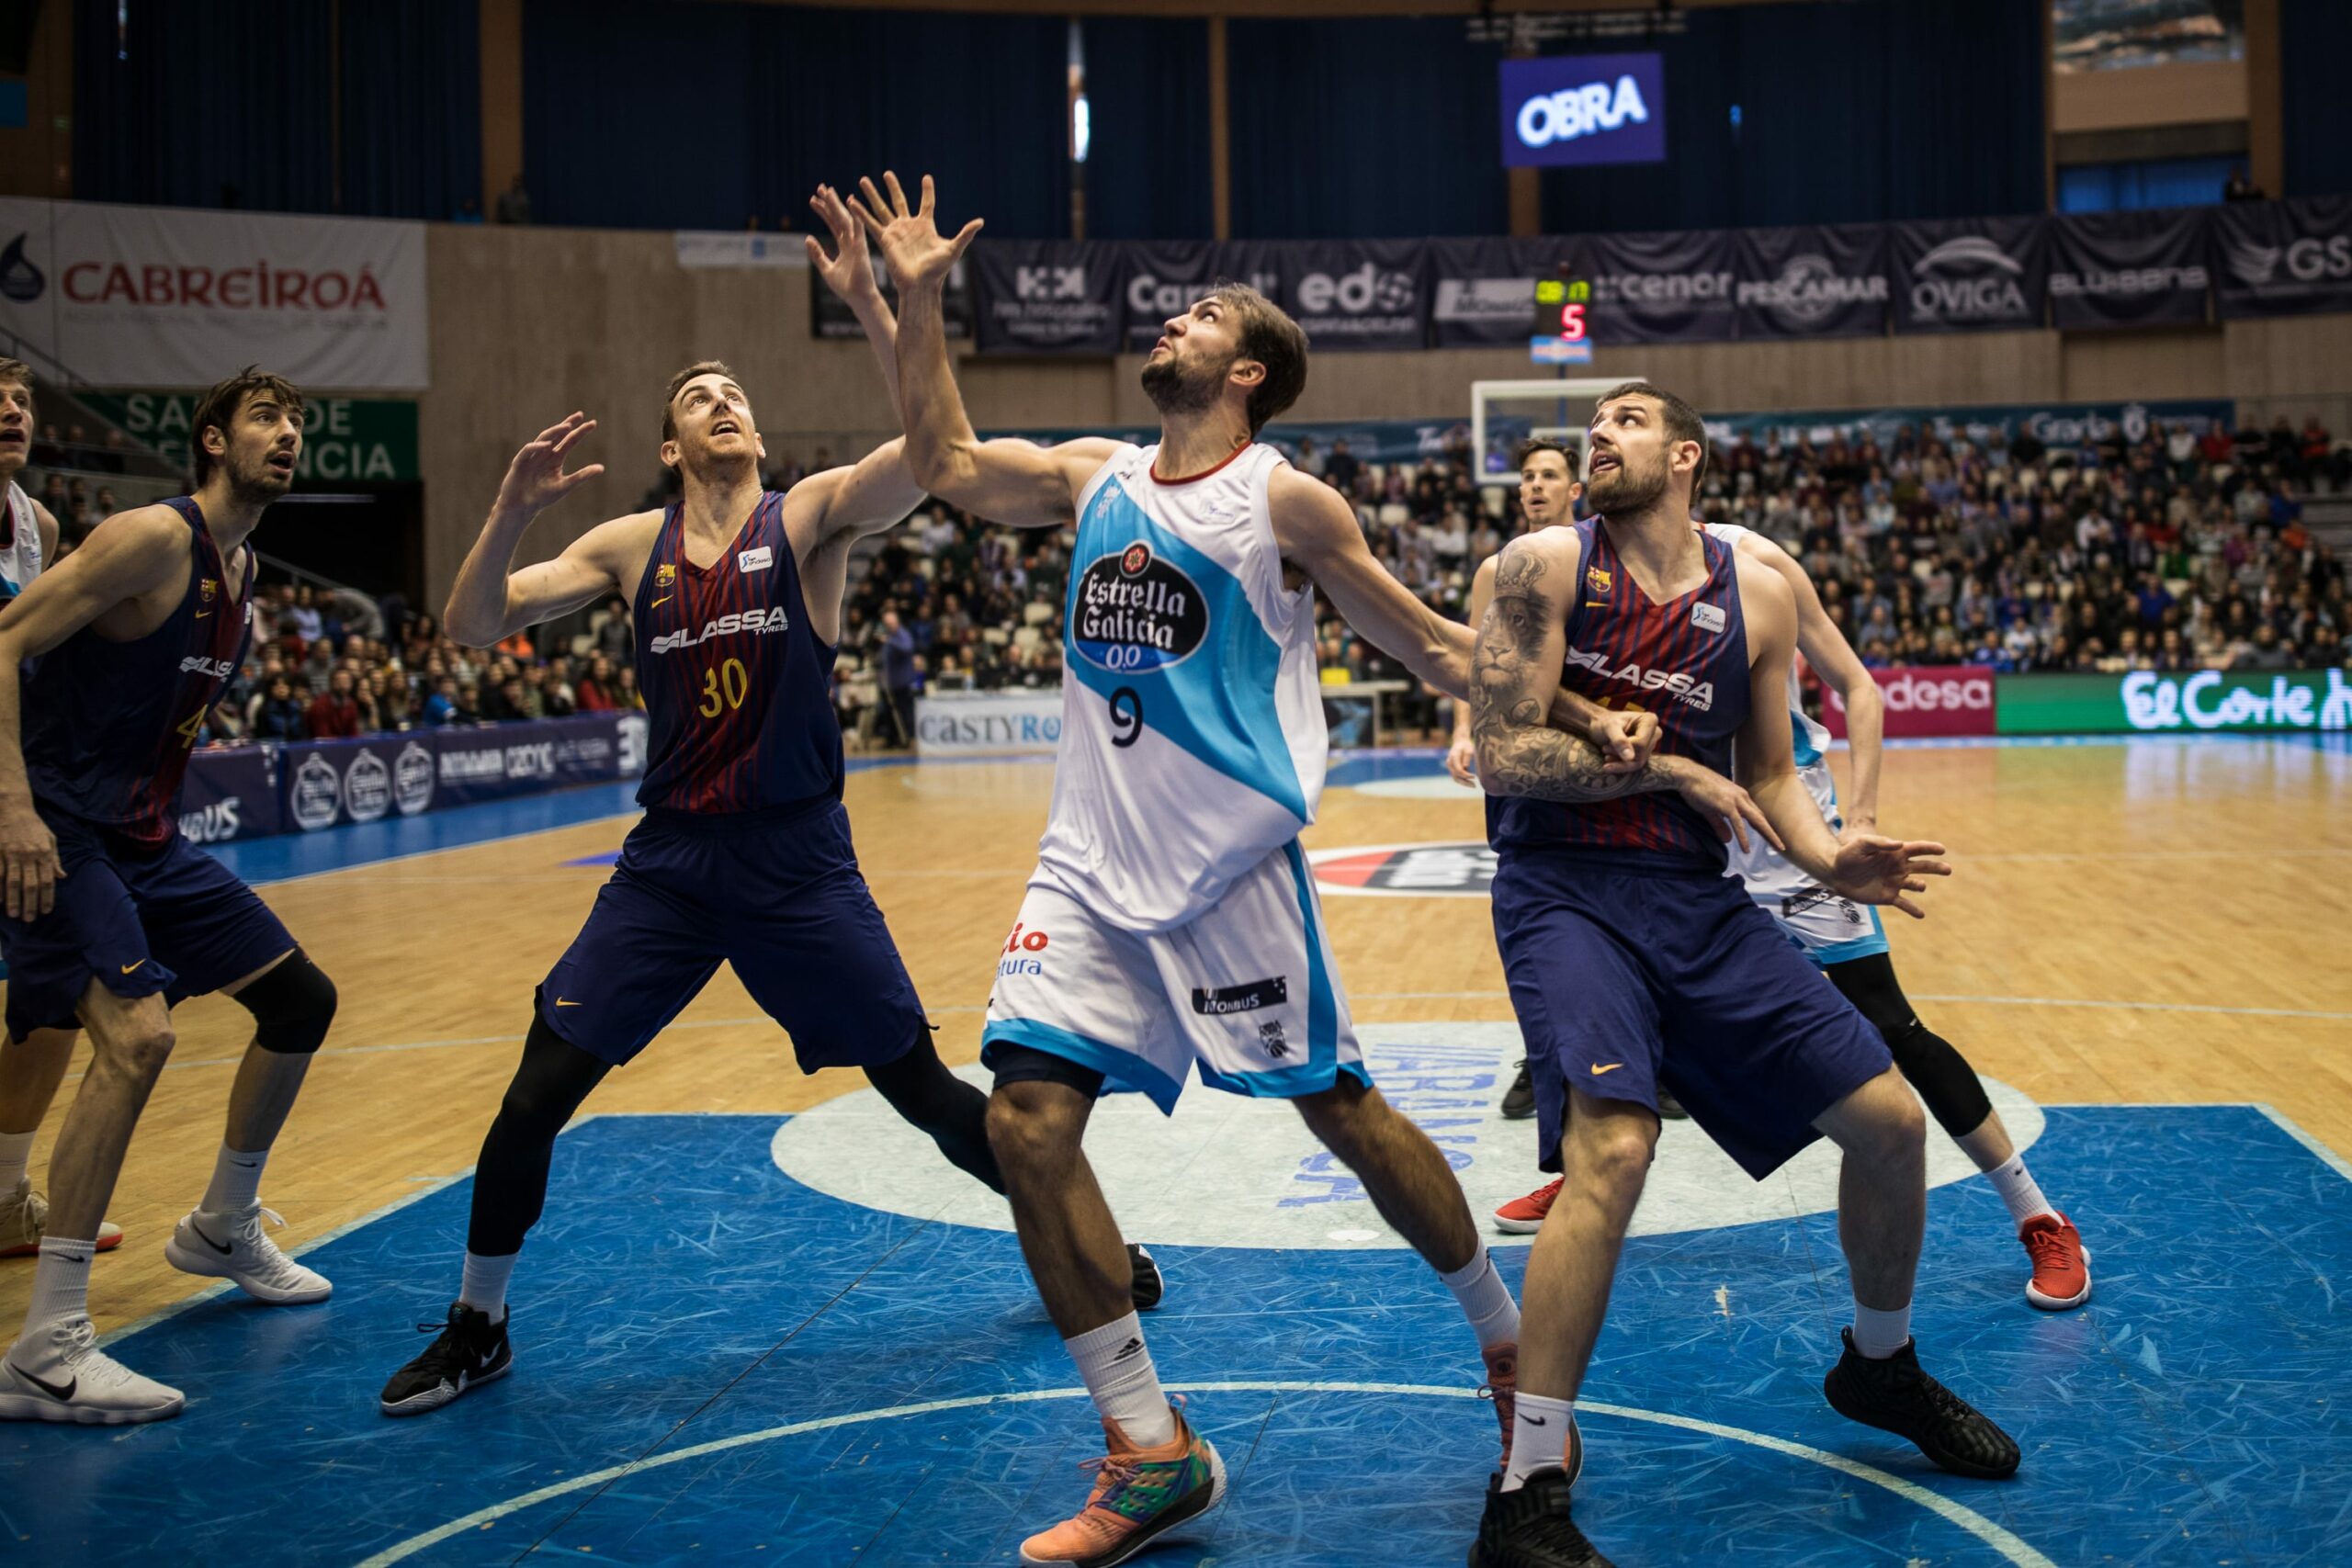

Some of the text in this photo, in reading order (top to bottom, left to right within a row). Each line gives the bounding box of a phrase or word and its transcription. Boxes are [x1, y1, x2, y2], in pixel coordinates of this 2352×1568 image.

[1517, 74, 1648, 148] OBRA
[1736, 275, 1888, 306] PESCAMAR
[1912, 278, 2025, 315] OVIGA
[1561, 303, 1586, 341] 5
[1084, 571, 1186, 617] Estrella
[679, 606, 788, 648] LASSA
[753, 623, 788, 636] TYRES
[1082, 605, 1174, 649] Galicia
[699, 658, 748, 718] 30
[1589, 651, 1714, 705] LASSA
[1830, 673, 1992, 712] desa
[1108, 686, 1144, 749] 9
[1672, 693, 1712, 712] TYRES
[2120, 670, 2182, 729] El
[2182, 670, 2315, 729] Corte
[179, 796, 241, 843] BUS
[1001, 922, 1048, 953] io
[997, 959, 1042, 977] tura
[1204, 993, 1260, 1013] MONBUS
